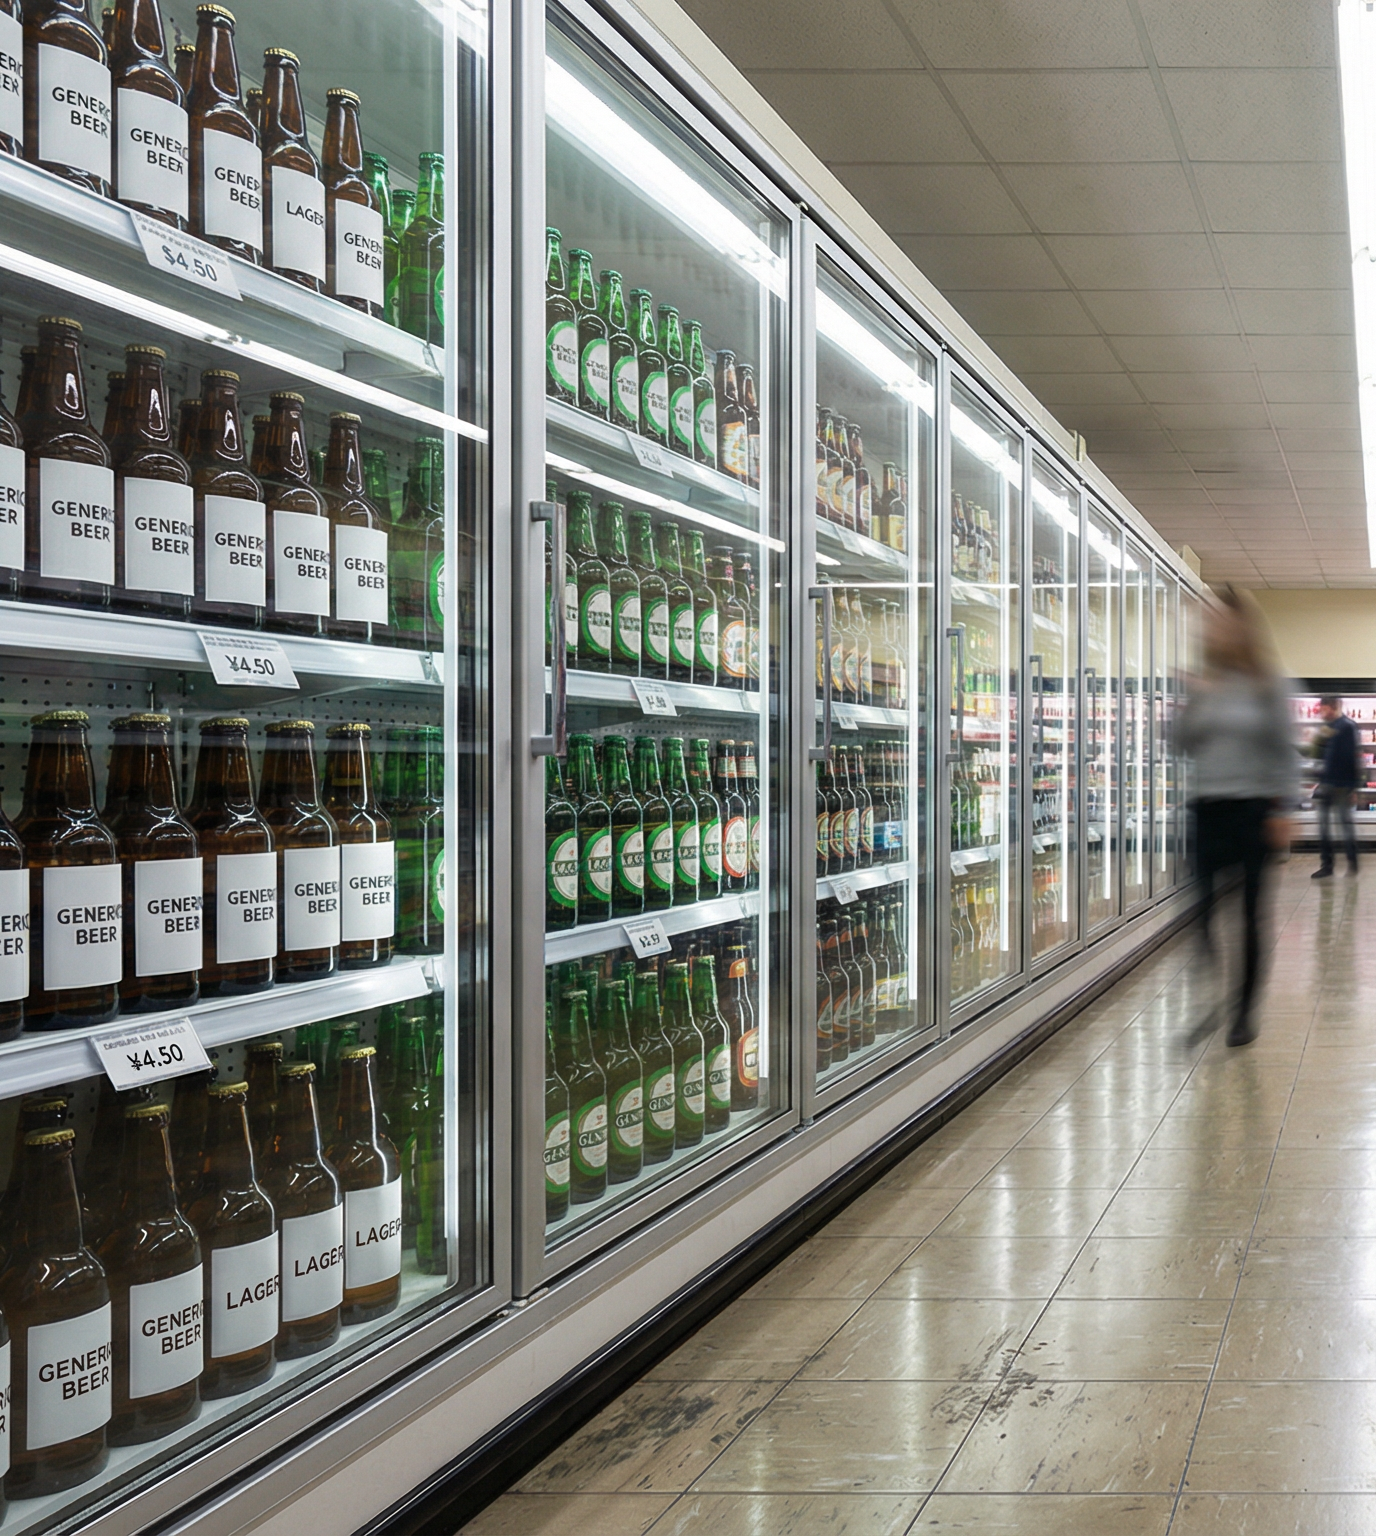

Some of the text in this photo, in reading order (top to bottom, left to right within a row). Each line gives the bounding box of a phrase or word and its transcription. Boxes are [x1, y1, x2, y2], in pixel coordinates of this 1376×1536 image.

[161, 244, 218, 282] $4.50
[71, 522, 111, 543] BEER
[151, 537, 190, 556] BEER
[243, 906, 275, 923] BEER
[75, 926, 118, 946] BEER
[355, 1217, 401, 1247] LAGER
[294, 1244, 344, 1278] LAGER
[226, 1274, 279, 1311] LAGER
[161, 1323, 202, 1355] BEER
[62, 1365, 110, 1401] BEER
